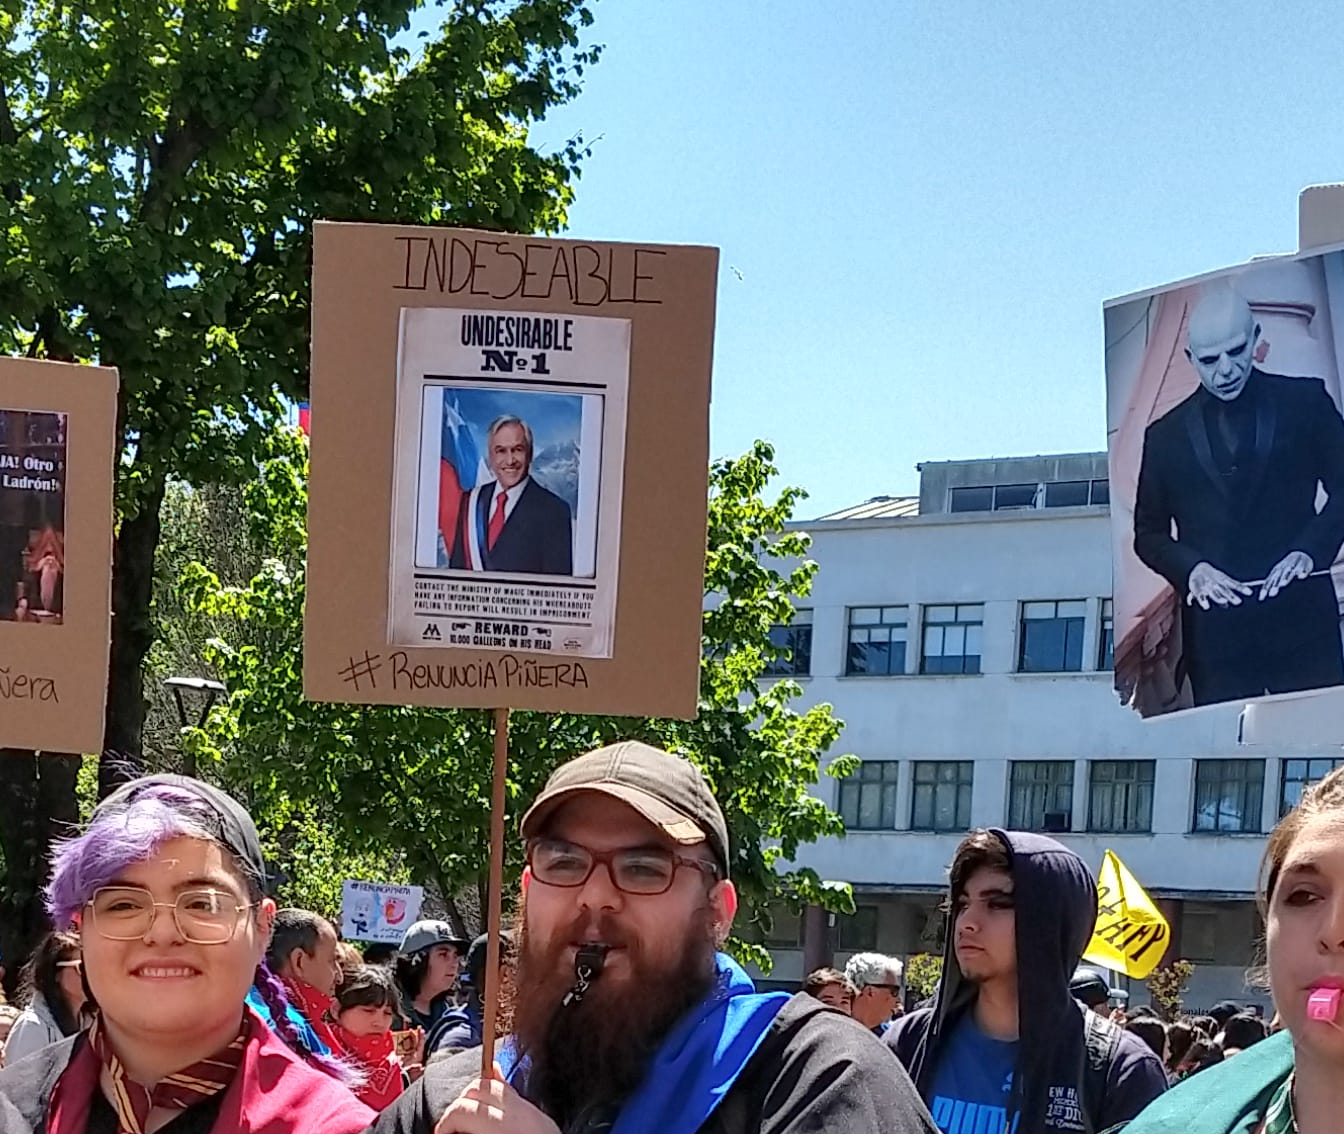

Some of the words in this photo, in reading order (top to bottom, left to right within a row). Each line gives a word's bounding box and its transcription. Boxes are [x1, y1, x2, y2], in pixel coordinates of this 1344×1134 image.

[392, 236, 667, 307] INDESEABLE
[461, 314, 574, 352] UNDESIRABLE
[23, 456, 54, 472] Otro
[2, 474, 57, 492] Ladrón!
[414, 581, 444, 591] CONTACT
[447, 583, 459, 592] THE
[462, 584, 492, 594] MINISTRY
[493, 586, 502, 595] OF
[504, 588, 525, 596] MAGIC
[526, 588, 572, 600] IMMEDIATELY
[582, 592, 595, 601] YOU
[414, 591, 431, 600] HAVE
[433, 592, 446, 600] ANY
[448, 593, 490, 604] INFORMATION
[492, 596, 531, 606] CONCERNING
[533, 599, 544, 607] HIS
[545, 600, 592, 610] WHEREABOUTS
[414, 600, 441, 610] FAILING
[444, 602, 452, 611] TO
[455, 603, 480, 612] REPORT
[482, 605, 499, 614] WILL
[501, 606, 527, 616] RESULT
[529, 607, 537, 616] IN
[539, 608, 591, 620] IMPRISONMENT
[474, 621, 529, 638] REWARD
[472, 635, 507, 648] GALLEONS
[508, 637, 518, 648] ON
[520, 638, 533, 649] HIS
[534, 639, 552, 651] HEAD
